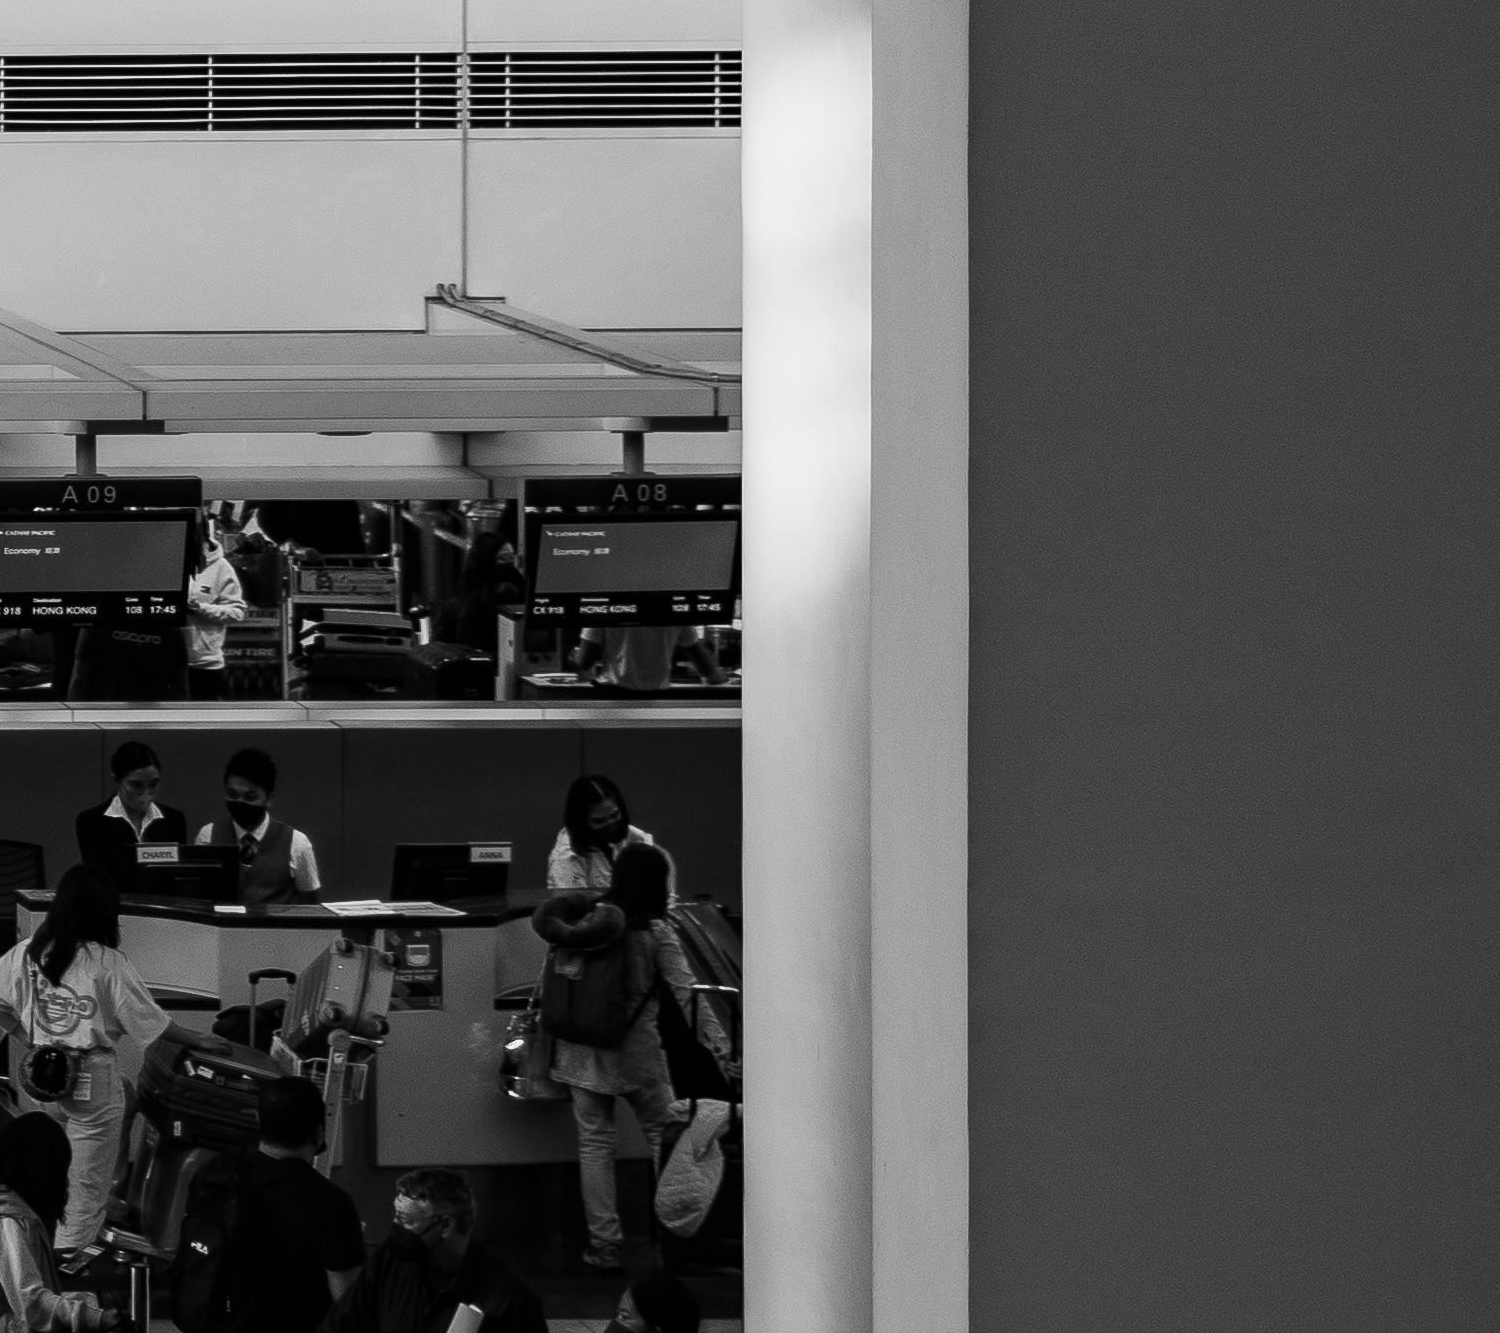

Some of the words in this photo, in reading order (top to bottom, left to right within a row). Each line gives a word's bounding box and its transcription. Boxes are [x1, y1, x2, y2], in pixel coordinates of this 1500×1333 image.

[87, 485, 117, 503] 09
[637, 483, 668, 502] 08
[32, 606, 63, 615] HONG
[66, 606, 97, 615] KONG
